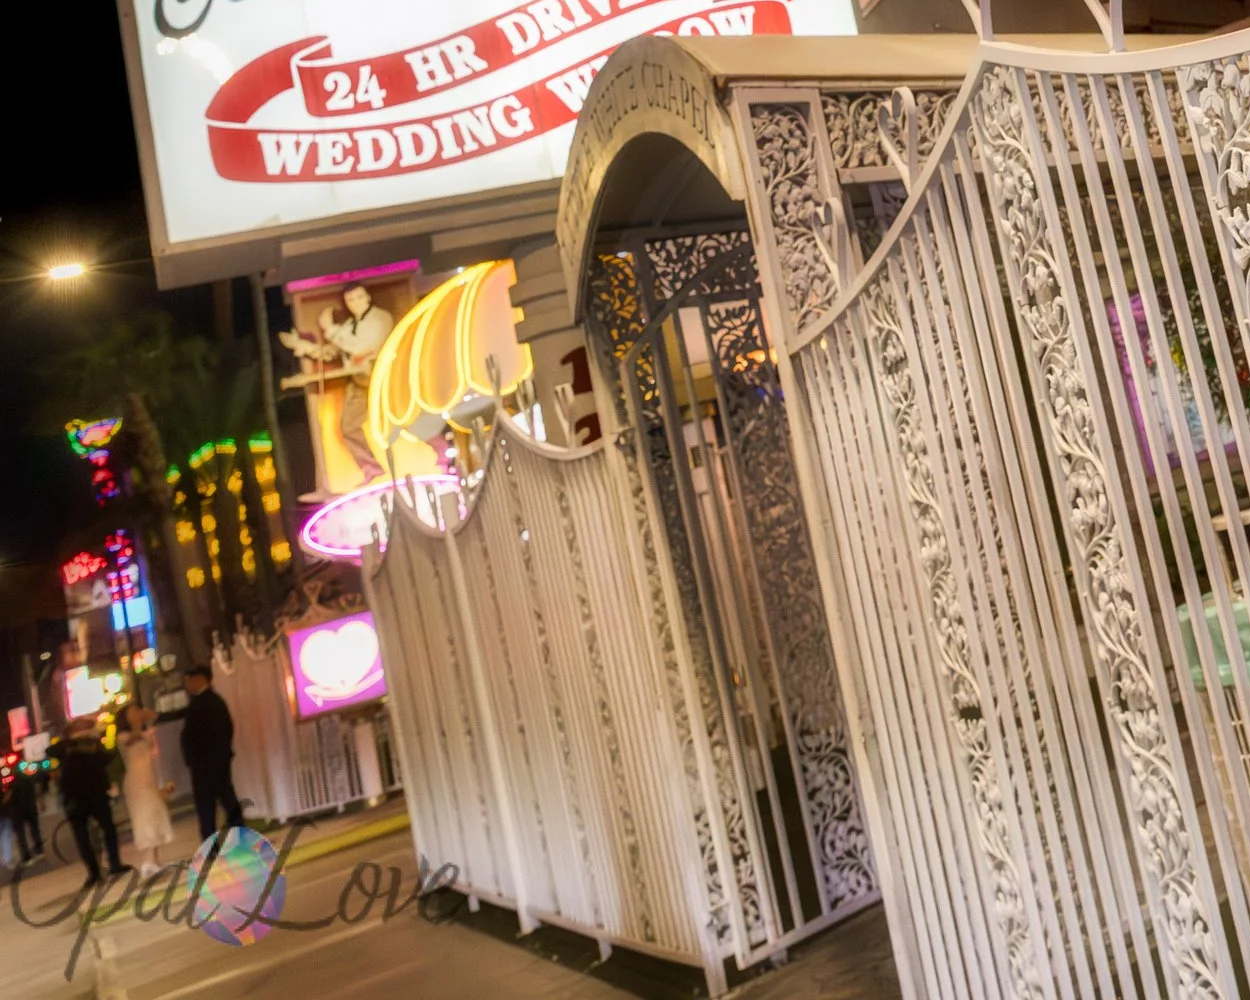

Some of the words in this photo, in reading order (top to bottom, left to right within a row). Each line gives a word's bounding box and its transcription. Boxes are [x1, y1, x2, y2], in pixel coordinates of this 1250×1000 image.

[322, 64, 387, 112] 24
[403, 33, 489, 93] HR
[640, 60, 716, 149] CHAPEL
[256, 93, 535, 177] WEDDING
